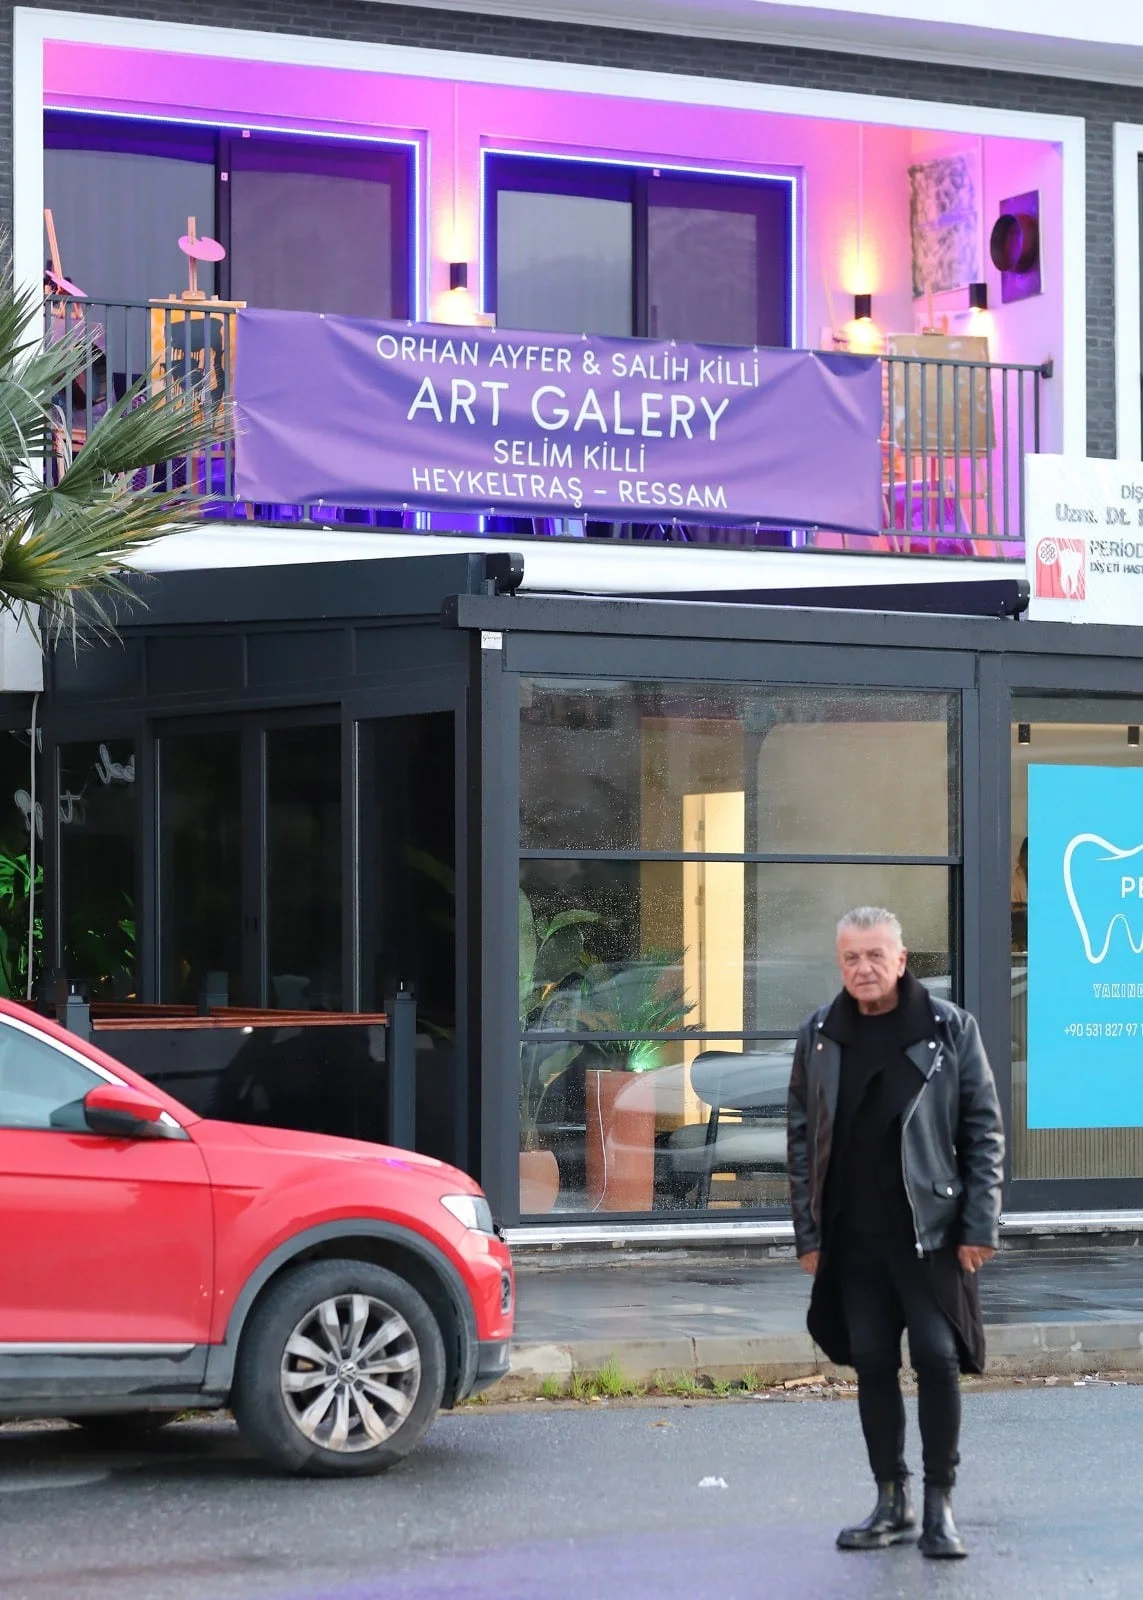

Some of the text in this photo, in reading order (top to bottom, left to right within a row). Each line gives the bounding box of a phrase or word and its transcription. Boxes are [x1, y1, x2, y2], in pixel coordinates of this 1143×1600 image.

[376, 335, 759, 387] ORHAN AYFER & SALİH KİLLİ
[407, 376, 729, 441] ART GALERY
[494, 437, 645, 473] SELİM KİLLİ
[412, 467, 583, 508] HEYKELTRAŞ
[618, 479, 728, 509] RESSAM
[1064, 1023, 1083, 1037] +90
[1086, 1023, 1102, 1037] 531
[1105, 1023, 1123, 1037] 827
[1126, 1023, 1138, 1037] 97
